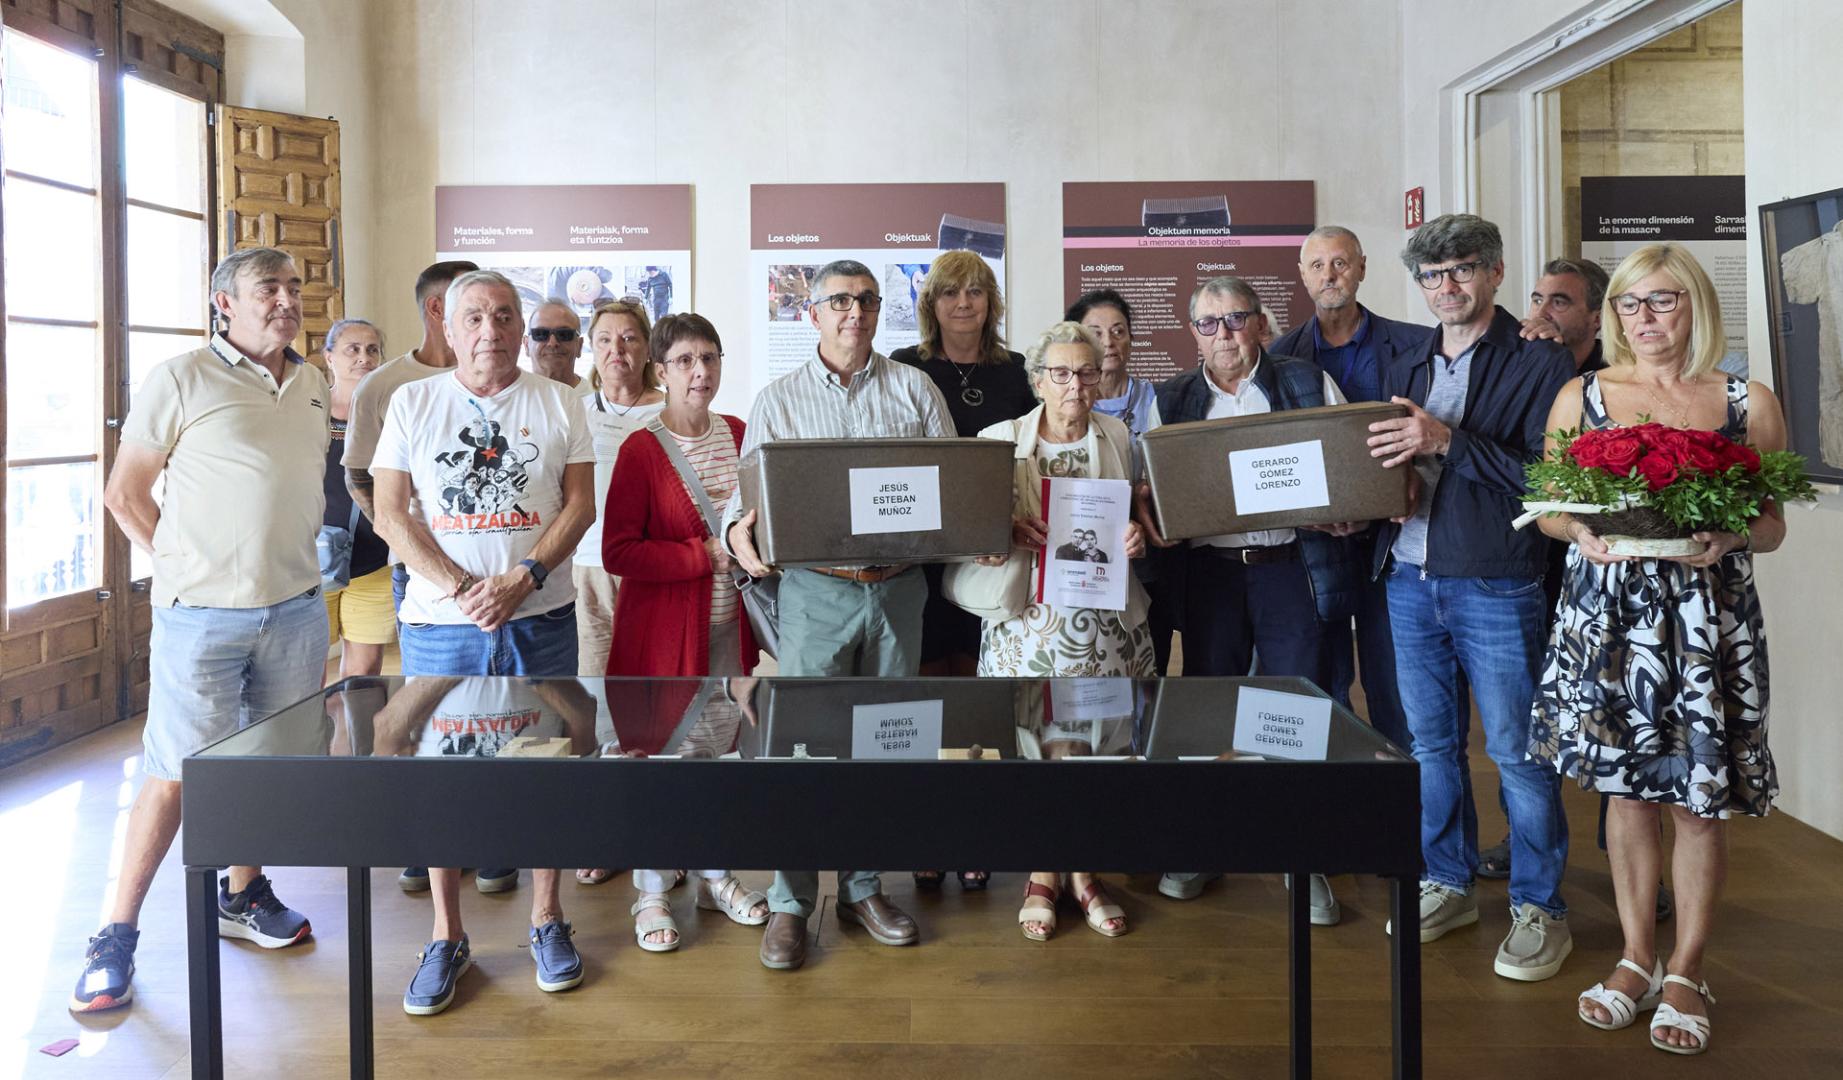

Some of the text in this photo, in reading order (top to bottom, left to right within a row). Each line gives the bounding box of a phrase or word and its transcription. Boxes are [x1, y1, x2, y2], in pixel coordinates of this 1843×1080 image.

[1599, 216, 1610, 225] La
[1648, 215, 1694, 225] dimensión
[453, 226, 534, 236] Materiales, forma
[570, 225, 649, 235] Materialak, forma
[1148, 227, 1192, 237] Objektuen
[1599, 226, 1610, 234] de
[1613, 225, 1620, 234] la
[453, 236, 496, 247] y función
[570, 235, 624, 244] eta funtzioa
[768, 233, 820, 243] Los objetos
[885, 233, 931, 243] Objektuak
[1211, 238, 1241, 247] objetos
[1081, 263, 1124, 273] Los objetos
[1197, 262, 1236, 272] Objektuak
[1251, 456, 1299, 469] GERARDO
[1259, 467, 1294, 479] GÓMEZ
[879, 482, 909, 493] JESÚS
[1255, 478, 1301, 490] LORENZO
[873, 494, 916, 505] ESTEBAN
[879, 506, 912, 516] MUÑOZ
